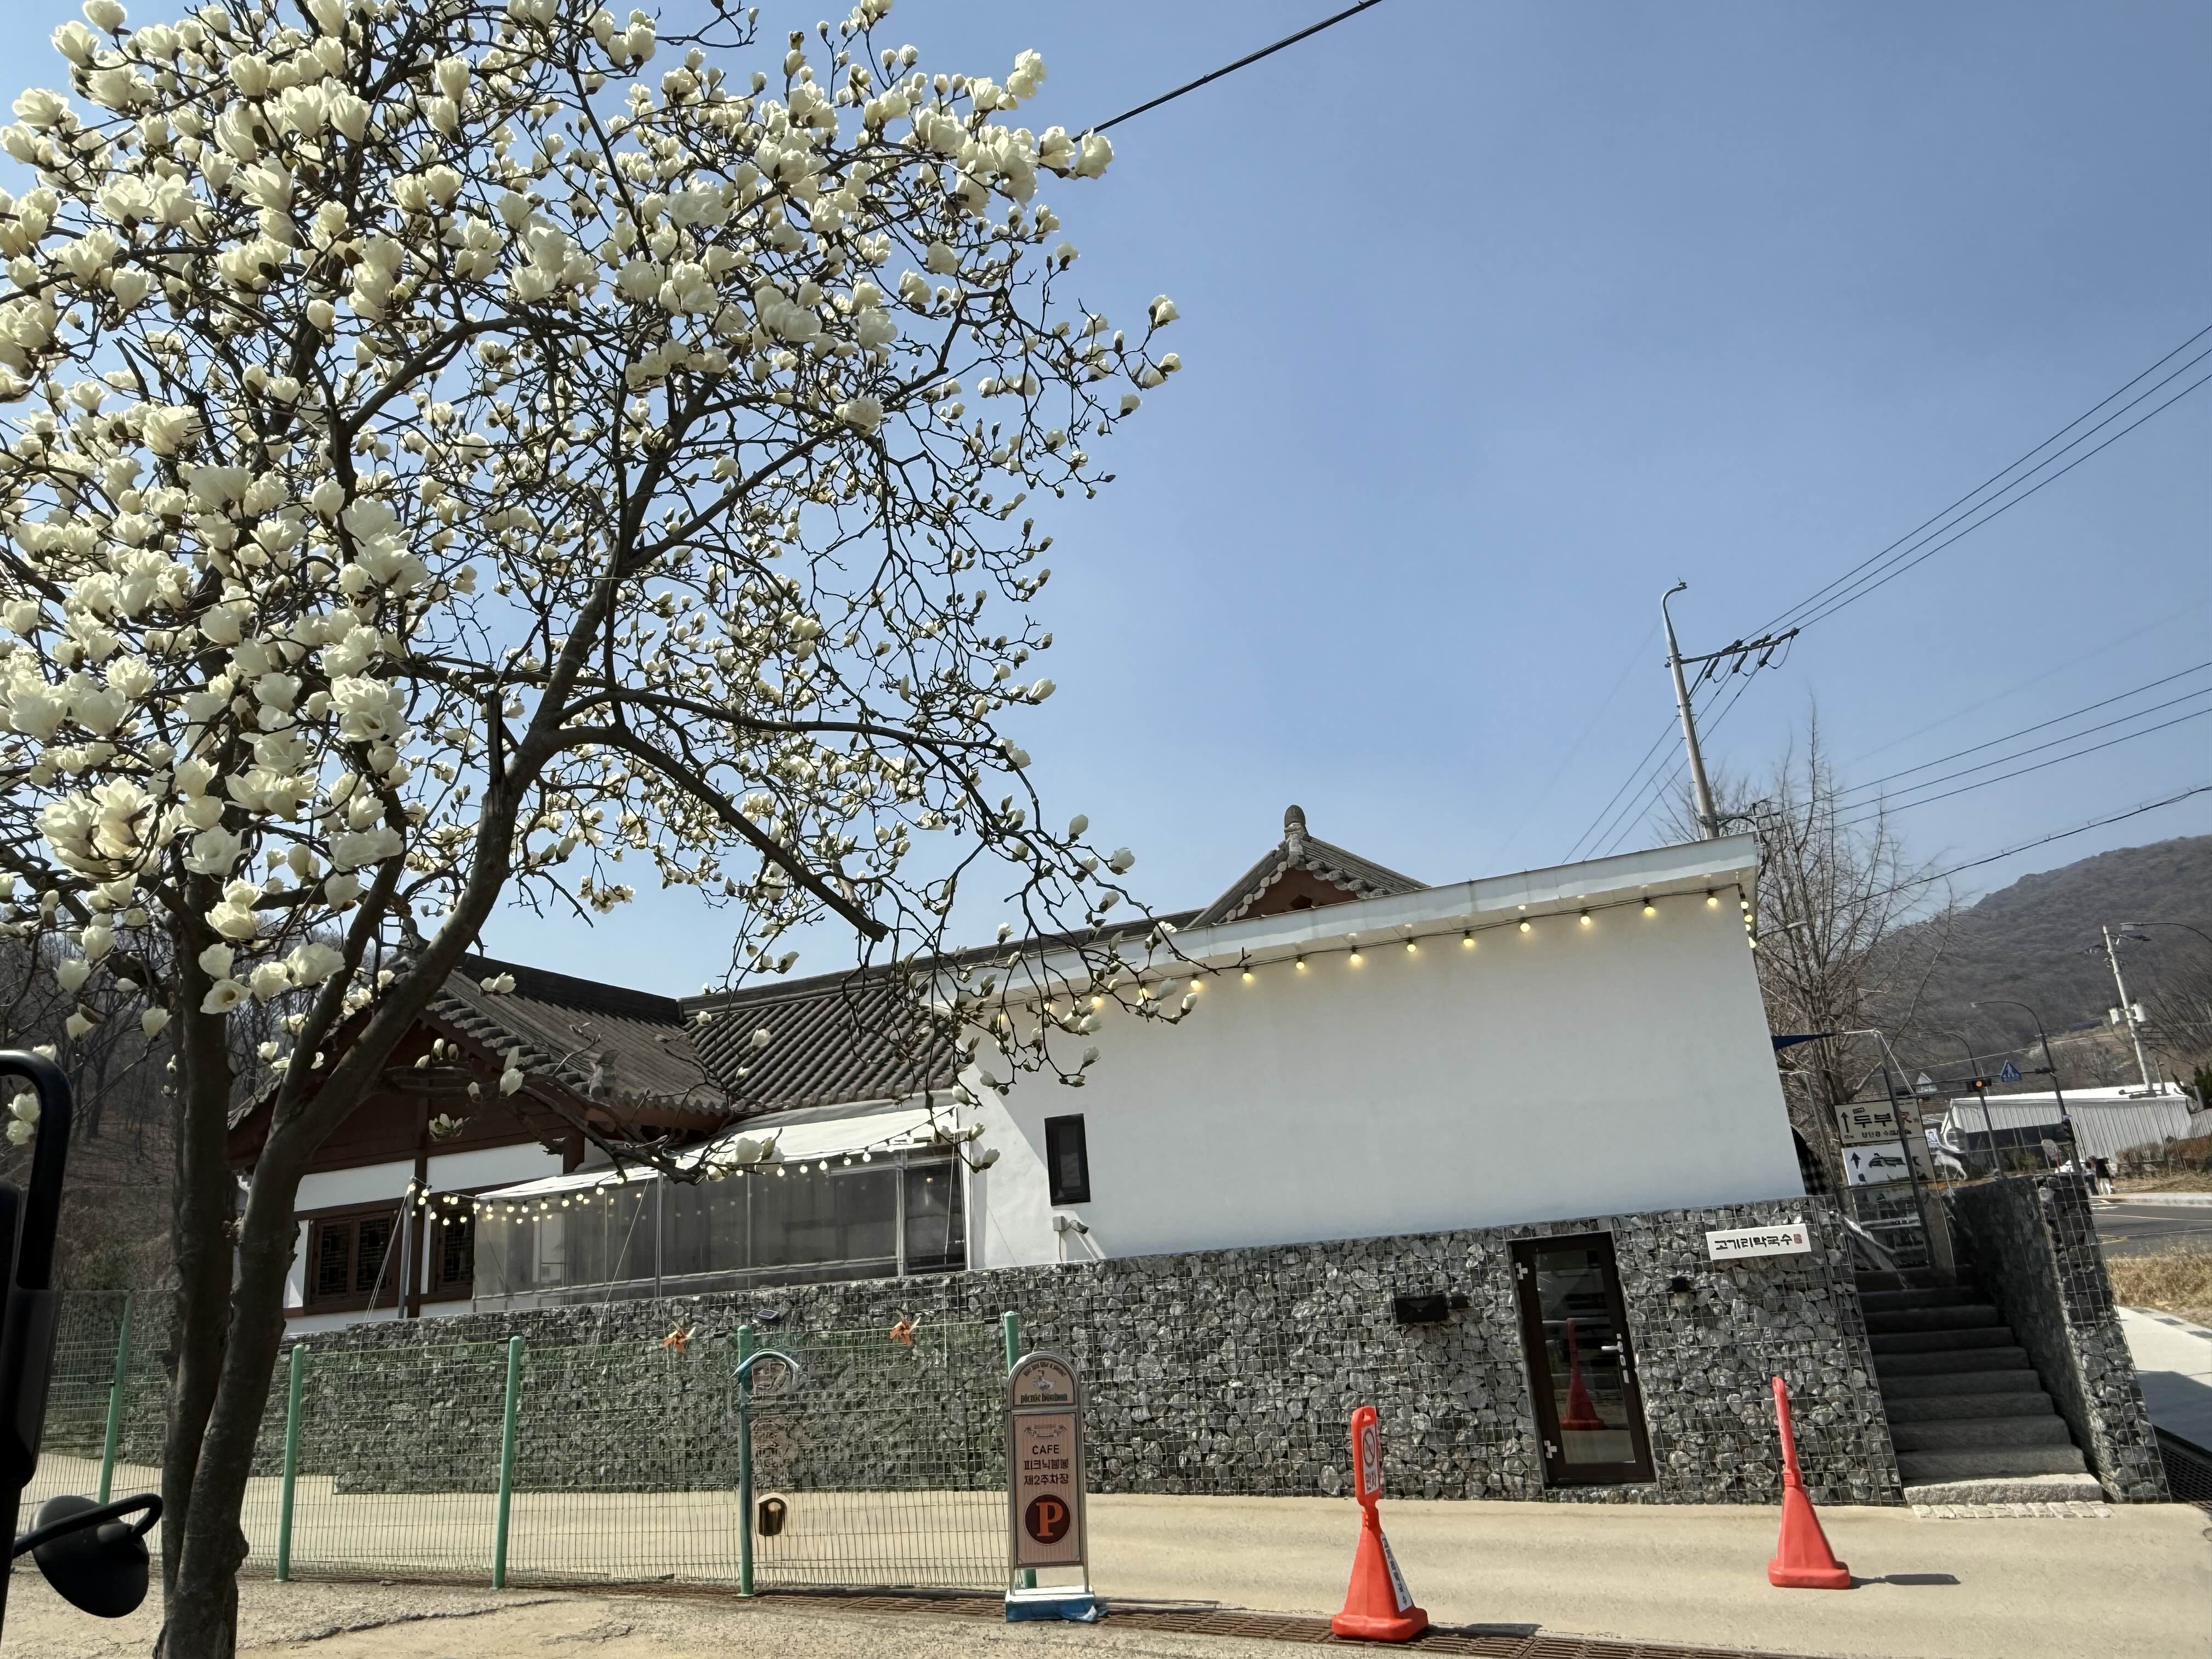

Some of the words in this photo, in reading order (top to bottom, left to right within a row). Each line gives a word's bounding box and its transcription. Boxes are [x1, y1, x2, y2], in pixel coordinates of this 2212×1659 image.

[1714, 1234, 1792, 1250] 고기리막국수
[1032, 1444, 1060, 1455] CAFE
[1024, 1474, 1069, 1486] 제2주차장
[1036, 1502, 1063, 1536] P
